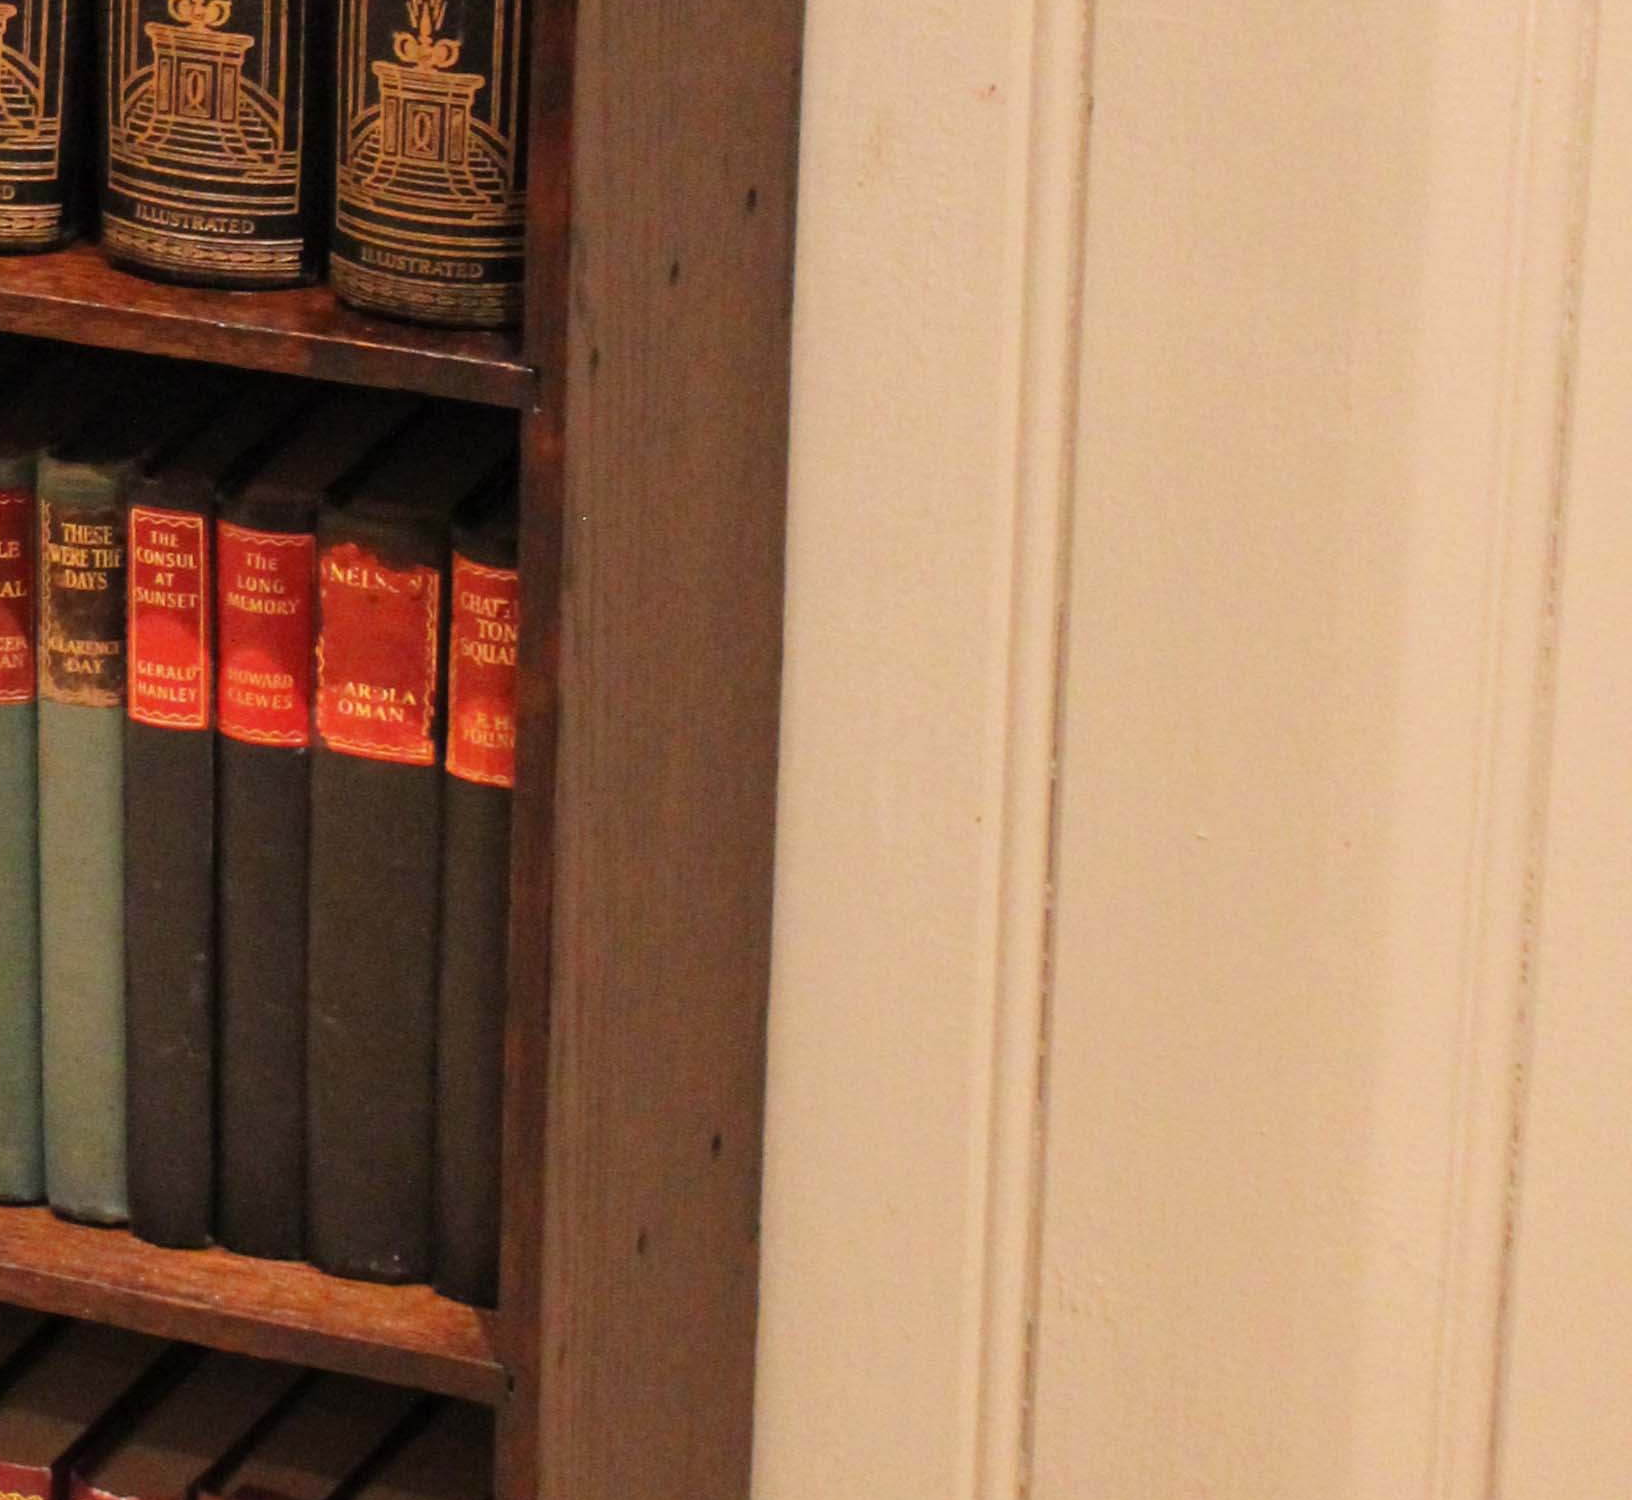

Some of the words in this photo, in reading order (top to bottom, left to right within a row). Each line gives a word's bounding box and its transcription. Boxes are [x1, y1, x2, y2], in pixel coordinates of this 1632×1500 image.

[134, 202, 256, 236] ILLUSTRATED
[360, 246, 484, 279] ILLUSTRATED
[61, 523, 113, 545] THESE
[150, 531, 178, 548] THE
[47, 543, 89, 568] WERE
[136, 548, 197, 569] CONSUL
[65, 570, 108, 591] DAYS
[155, 572, 174, 587] AT
[237, 574, 285, 594] LONG
[134, 587, 198, 609] SUNSET
[226, 592, 297, 616] MEMORY
[68, 658, 104, 674] DAY
[137, 661, 200, 681] GERALD
[228, 668, 294, 689] HOWARD
[137, 681, 197, 702] HANLEY
[227, 689, 292, 710] CLEWES
